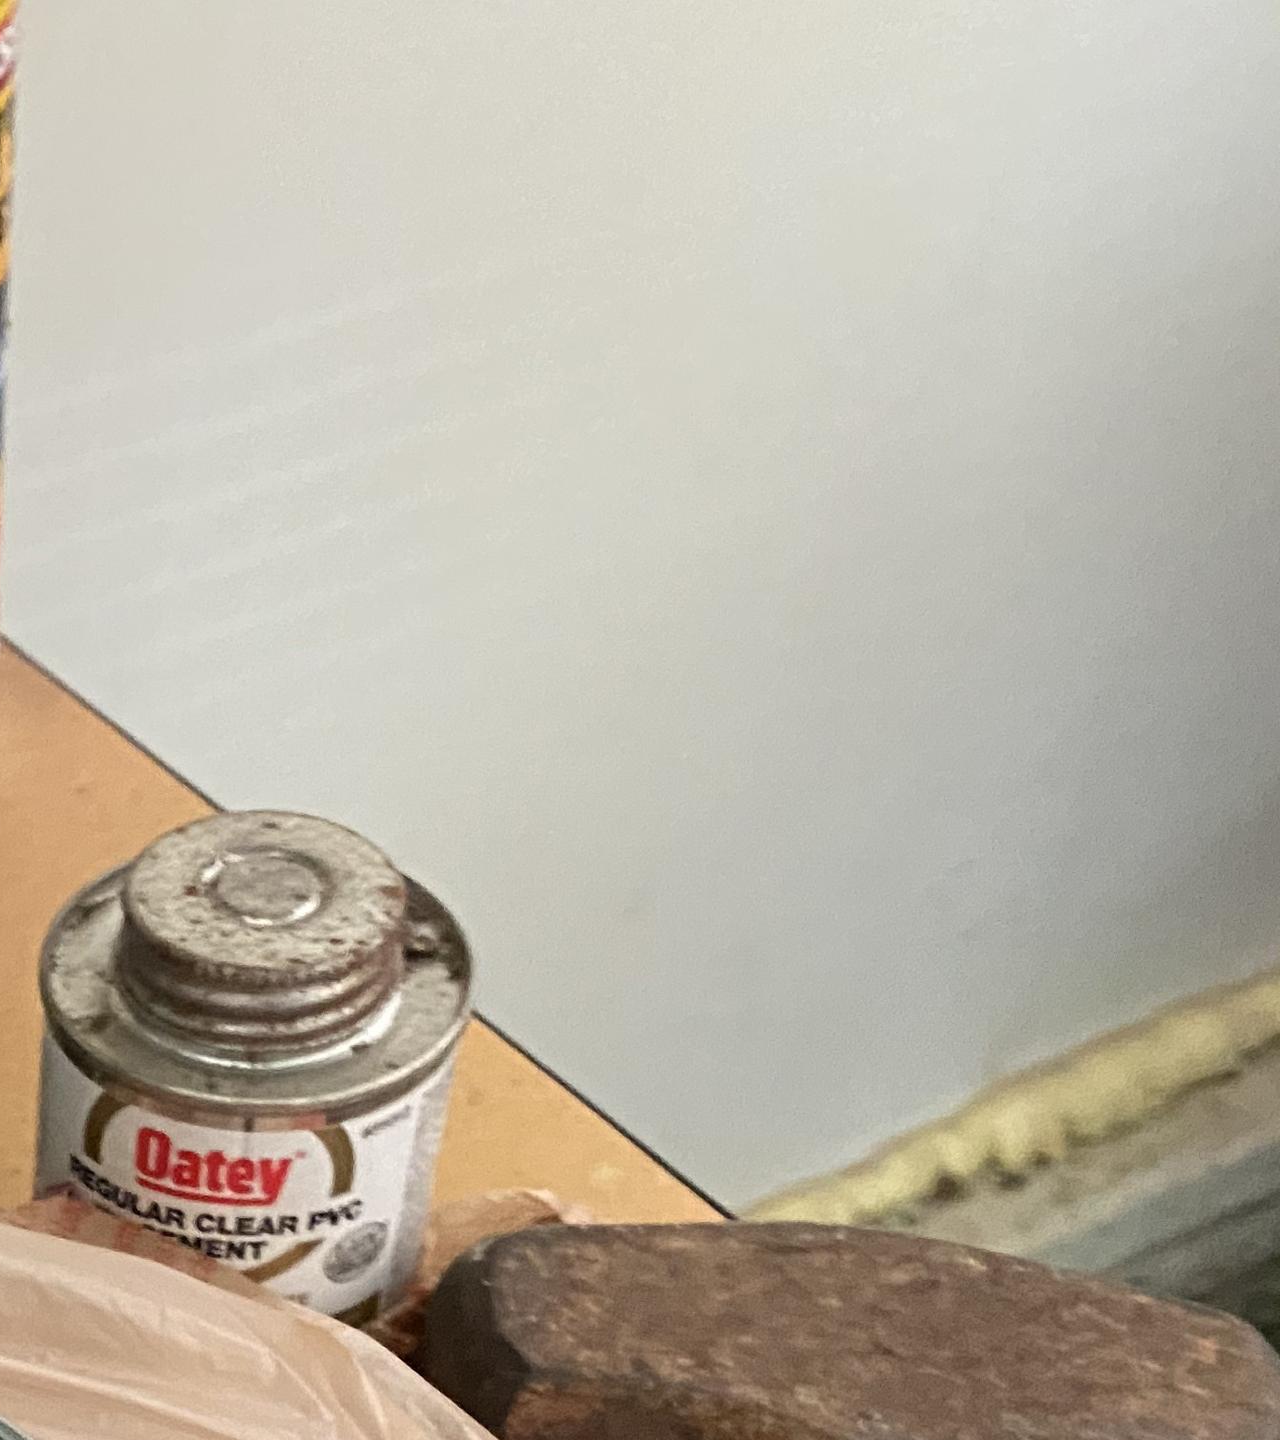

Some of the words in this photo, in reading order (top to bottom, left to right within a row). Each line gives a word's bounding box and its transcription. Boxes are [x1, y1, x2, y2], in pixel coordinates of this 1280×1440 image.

[69, 1152, 185, 1230] REGULAR
[194, 1212, 299, 1237] CLEAR
[308, 1199, 363, 1231] PVC
[135, 1126, 292, 1207] Oatey
[143, 1222, 268, 1261] MENT
